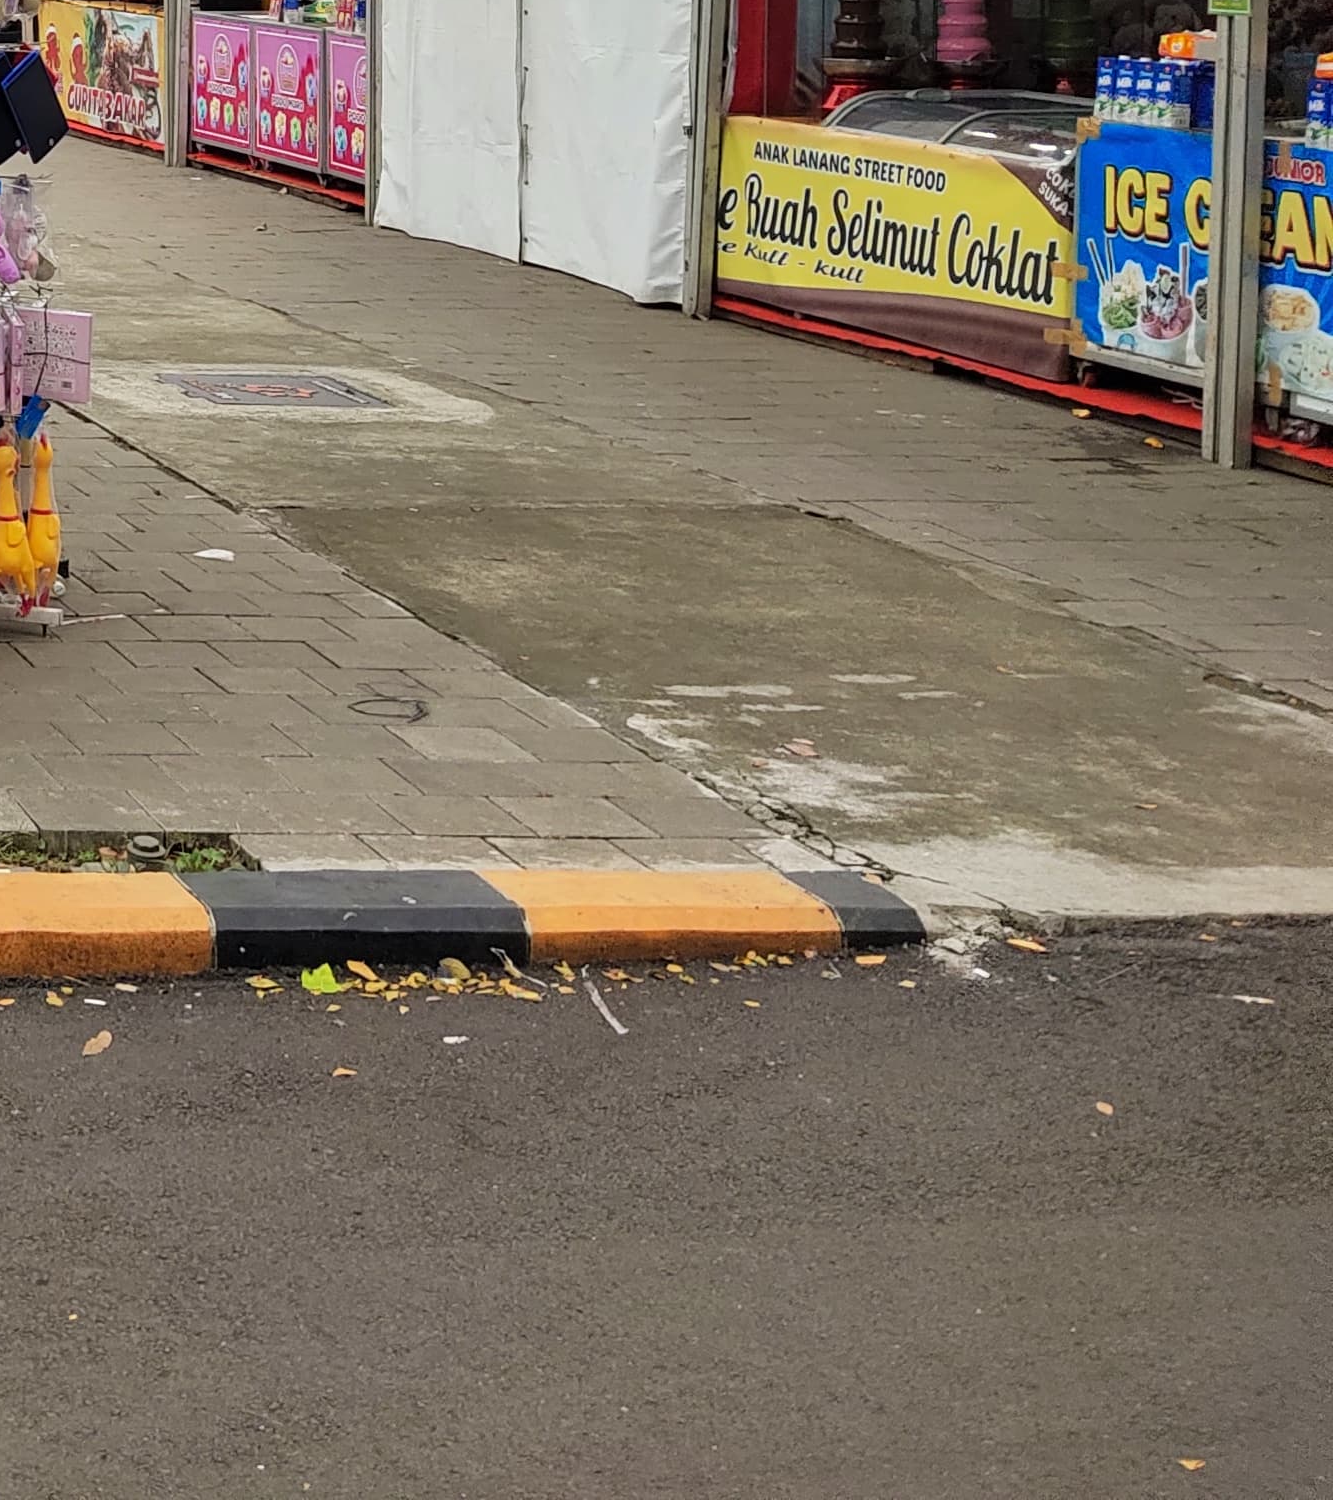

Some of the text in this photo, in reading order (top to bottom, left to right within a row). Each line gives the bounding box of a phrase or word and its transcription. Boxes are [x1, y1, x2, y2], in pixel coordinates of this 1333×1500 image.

[67, 83, 147, 127] GURITA BAKAR
[753, 140, 947, 193] ANAK LANANG STREET FOOD
[1103, 164, 1172, 243] ICE
[743, 173, 818, 251] Buah
[826, 188, 941, 277] Selimut
[947, 212, 1061, 306] Coklat
